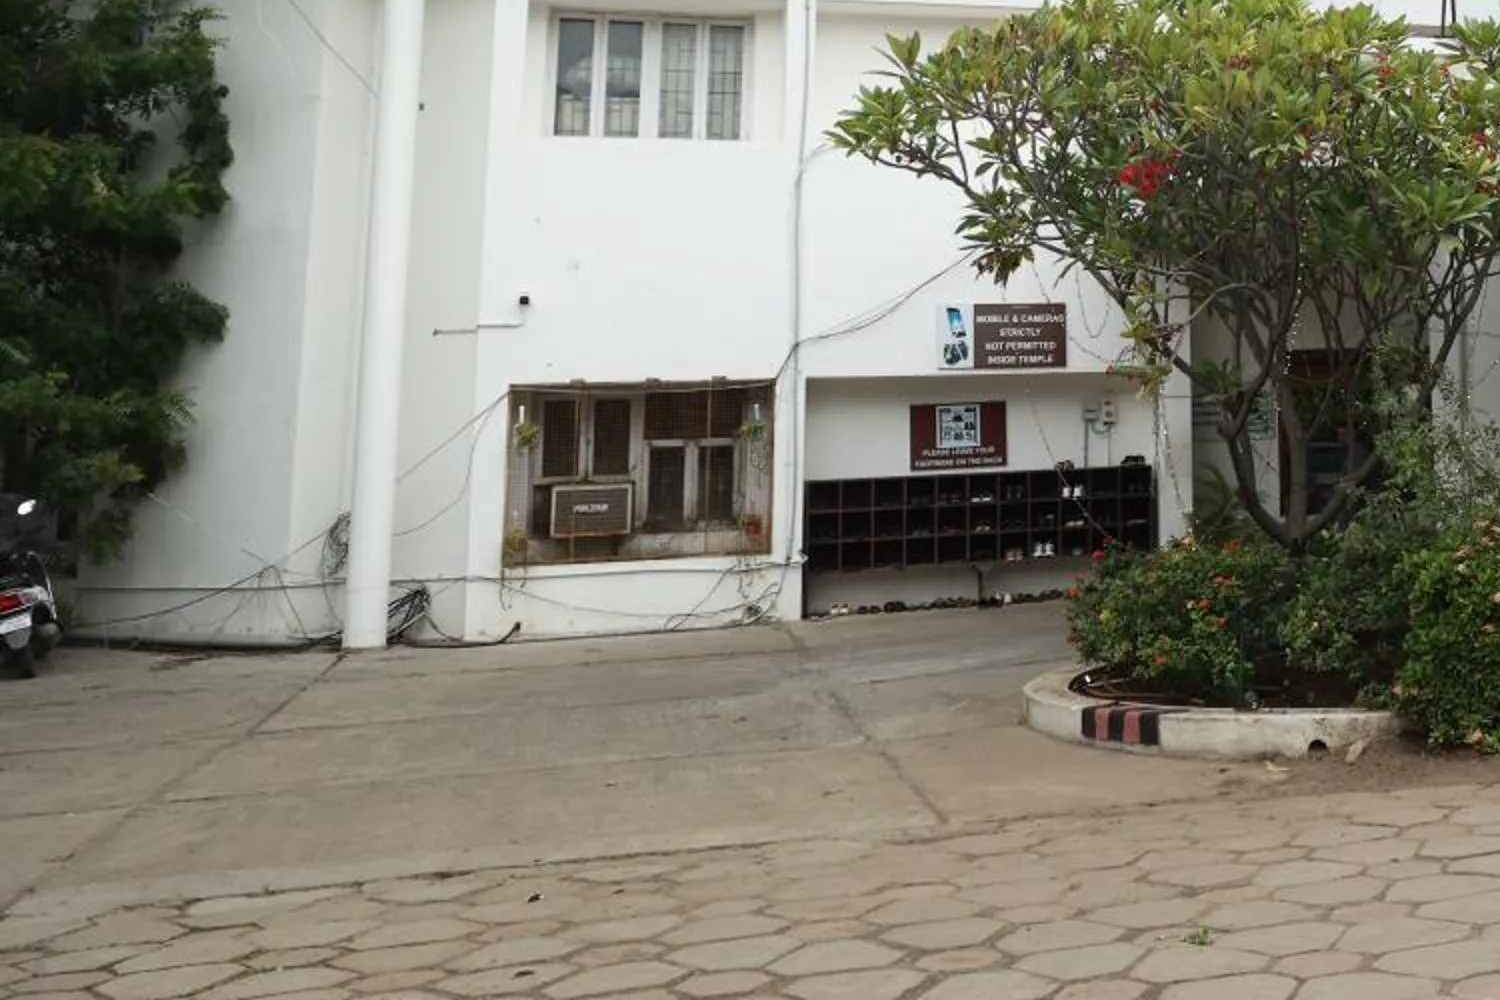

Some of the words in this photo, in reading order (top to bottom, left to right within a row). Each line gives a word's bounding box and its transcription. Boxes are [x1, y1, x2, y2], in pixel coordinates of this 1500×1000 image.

[976, 314, 1009, 323] MOBILE
[1021, 313, 1064, 323] CAMERAS
[999, 327, 1042, 337] STRICTLY
[985, 341, 1004, 351] NOT
[1006, 341, 1057, 351] PERMITTED
[1019, 354, 1054, 364] TEMPLE
